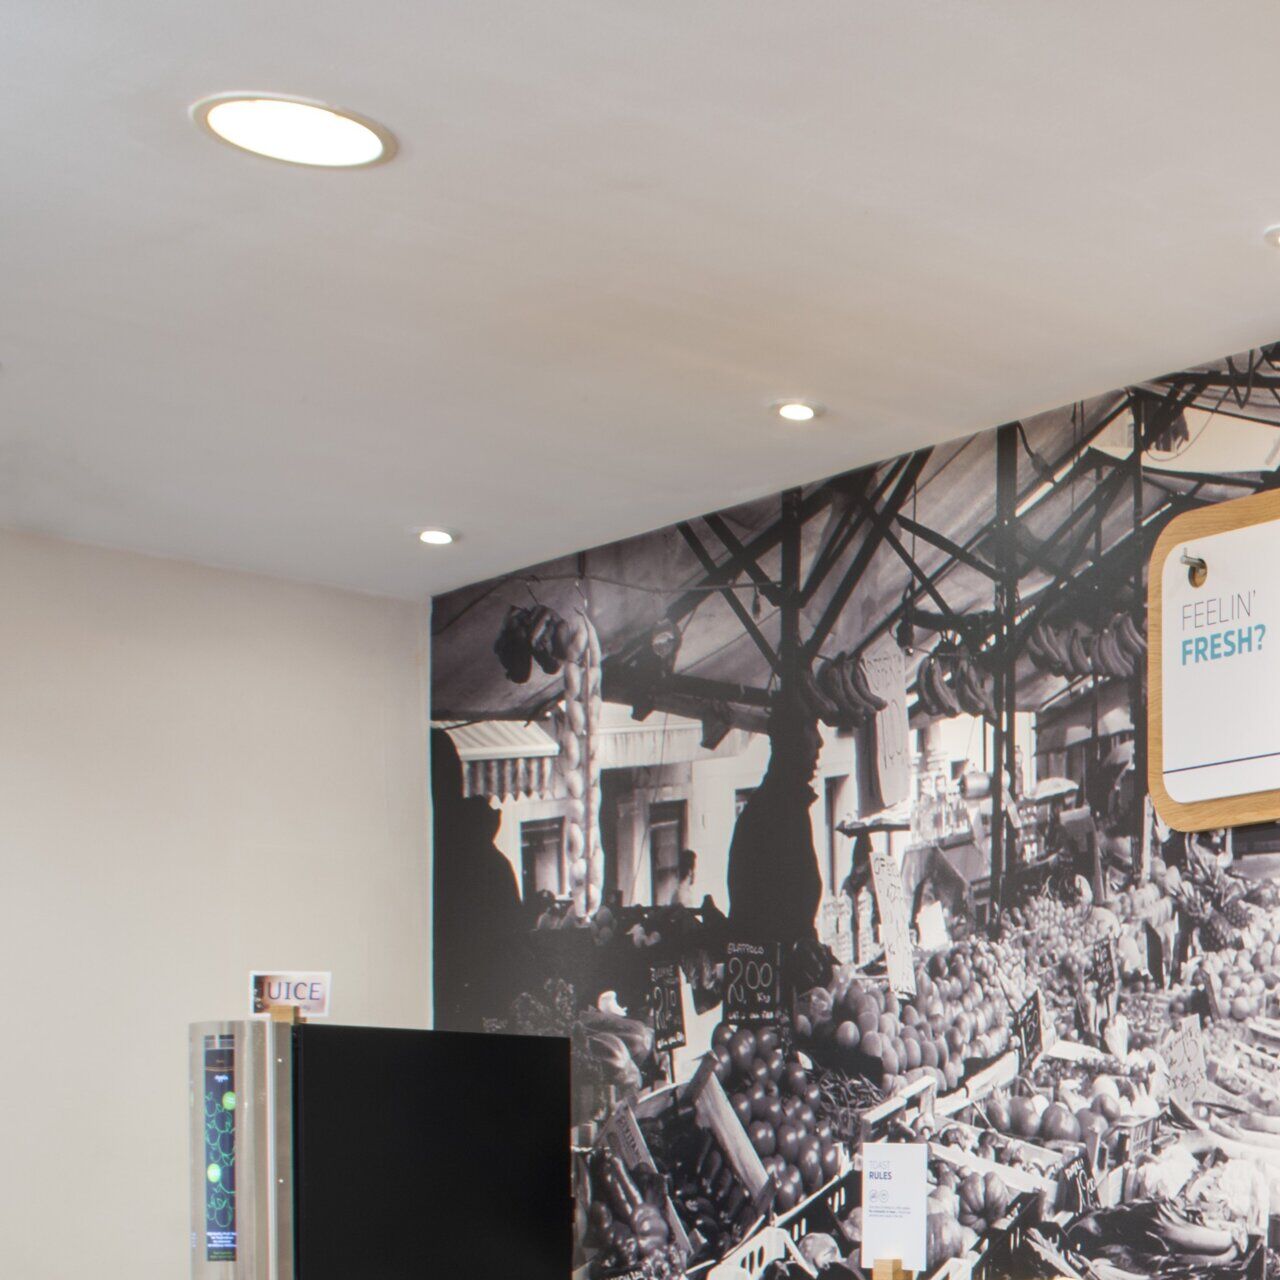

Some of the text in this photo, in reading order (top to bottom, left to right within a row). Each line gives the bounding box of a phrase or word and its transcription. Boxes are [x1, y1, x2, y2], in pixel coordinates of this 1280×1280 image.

[1181, 624, 1267, 665] FRESH?
[262, 981, 322, 1001] UICE
[869, 1171, 892, 1180] RULES
